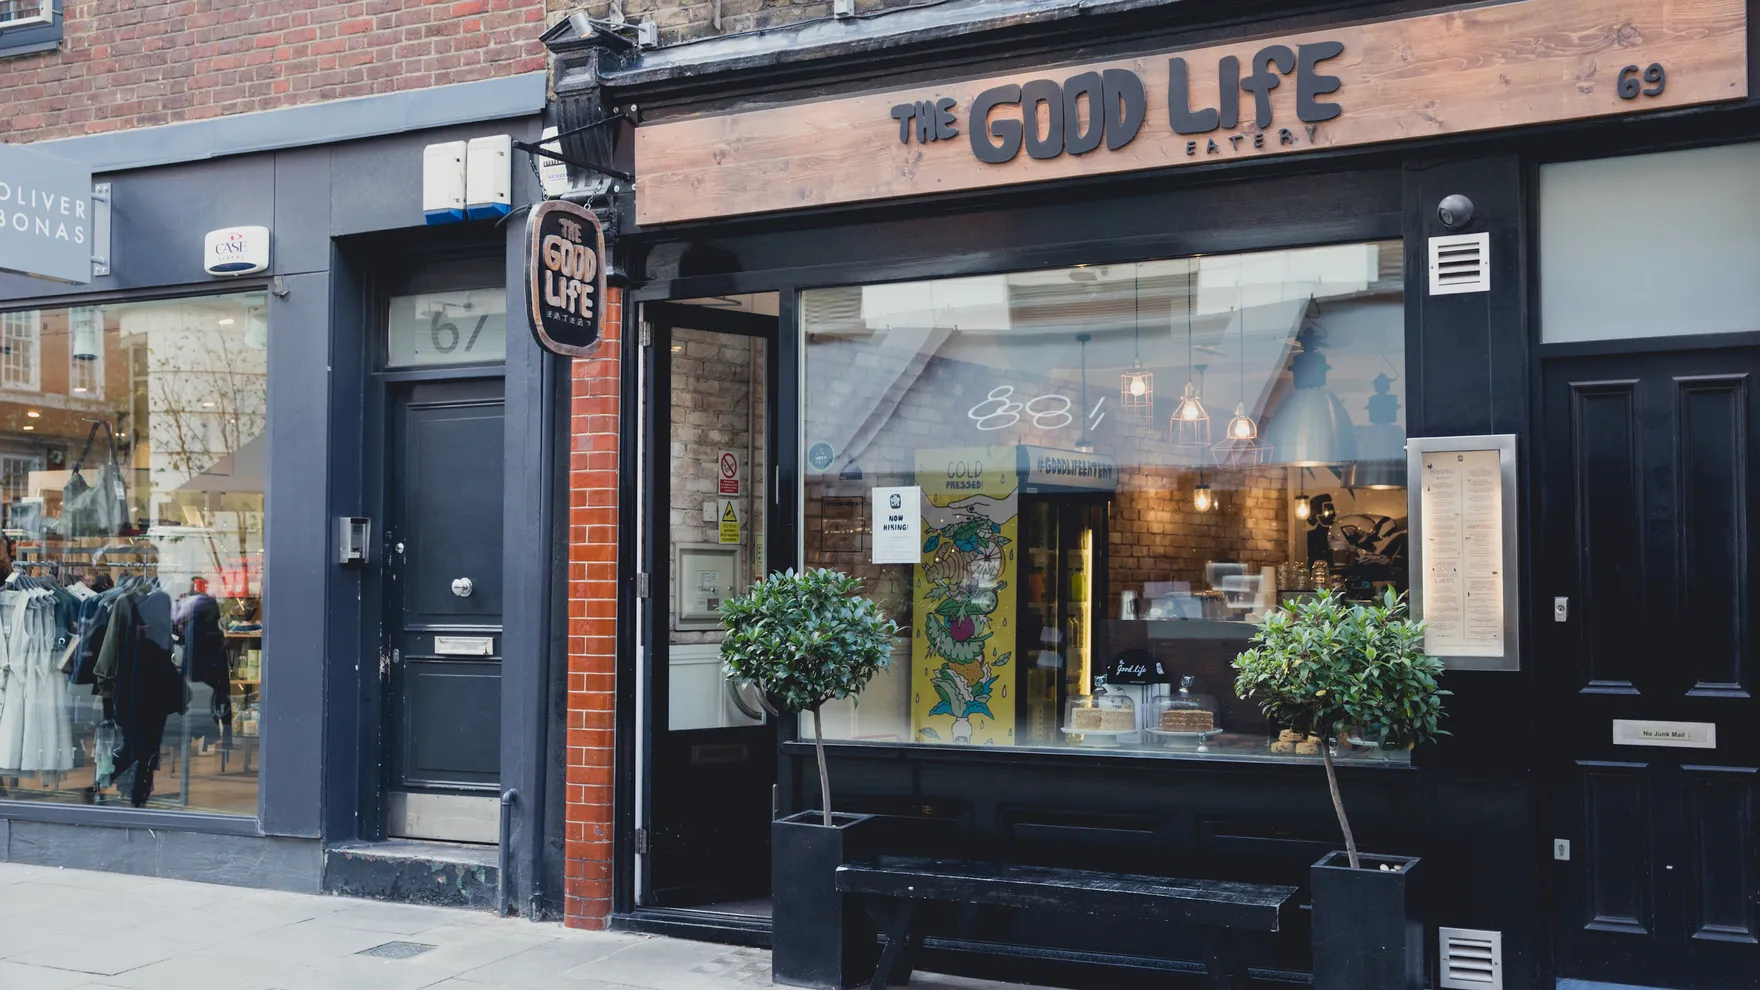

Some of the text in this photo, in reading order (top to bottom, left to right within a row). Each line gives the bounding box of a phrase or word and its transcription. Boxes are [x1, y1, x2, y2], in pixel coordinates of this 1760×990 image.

[1617, 62, 1666, 100] 69
[890, 97, 959, 145] THE
[968, 67, 1147, 165] GOOD
[1185, 125, 1318, 156] EATERY
[0, 181, 86, 219] OLIVER
[558, 218, 582, 243] THE
[215, 241, 248, 255] CASE
[543, 234, 597, 283] GOOD
[546, 311, 592, 328] EATERY
[947, 460, 983, 479] COLD
[946, 479, 984, 490] PRESSED!
[888, 514, 904, 522] NOW
